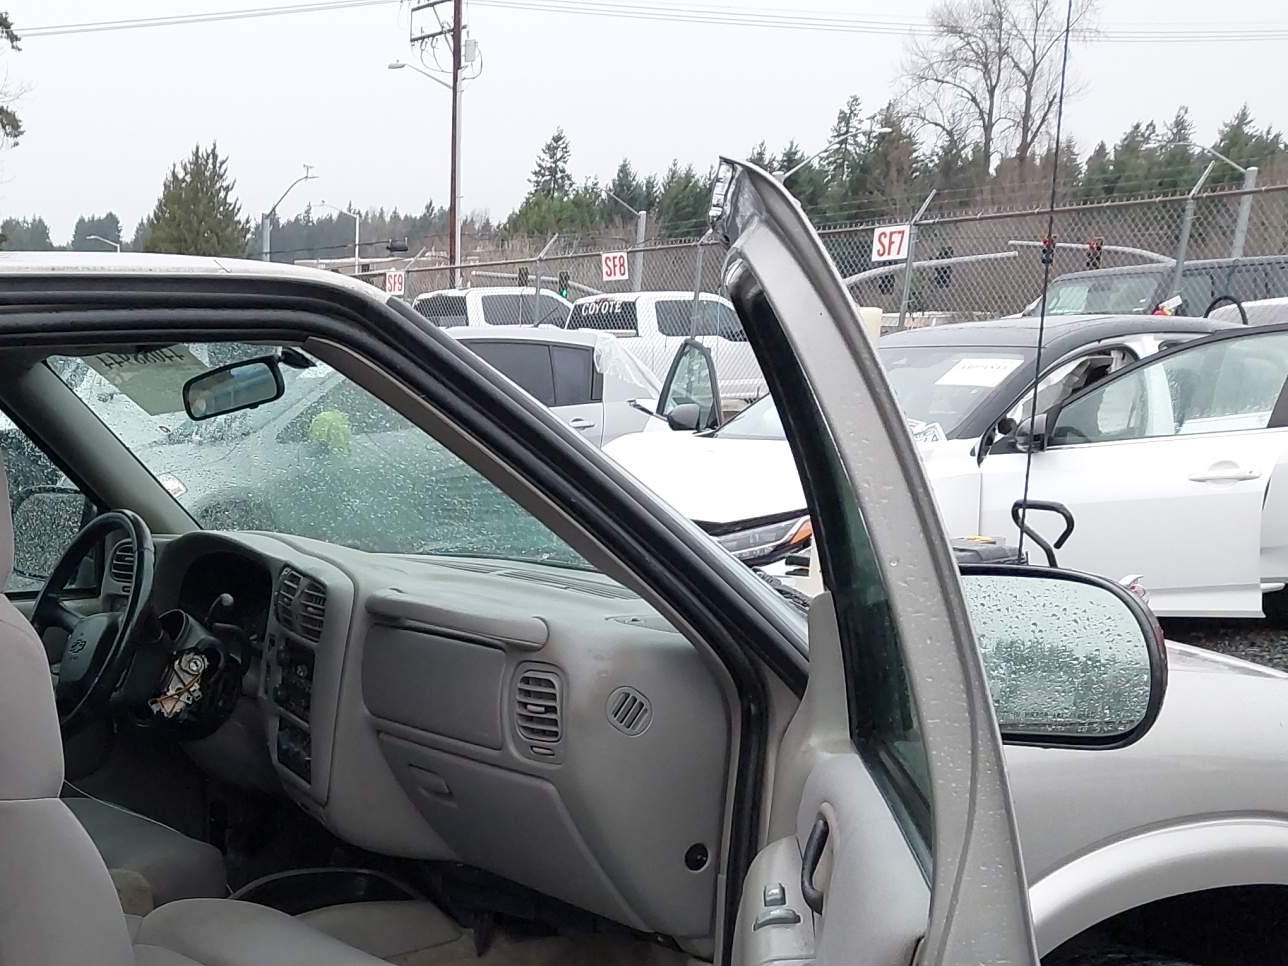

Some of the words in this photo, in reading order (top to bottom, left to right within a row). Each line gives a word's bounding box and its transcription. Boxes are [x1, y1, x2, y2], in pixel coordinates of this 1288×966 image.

[877, 230, 905, 257] SF7
[604, 255, 626, 277] SF8
[387, 273, 404, 293] SF9
[582, 300, 623, 316] COYOTE
